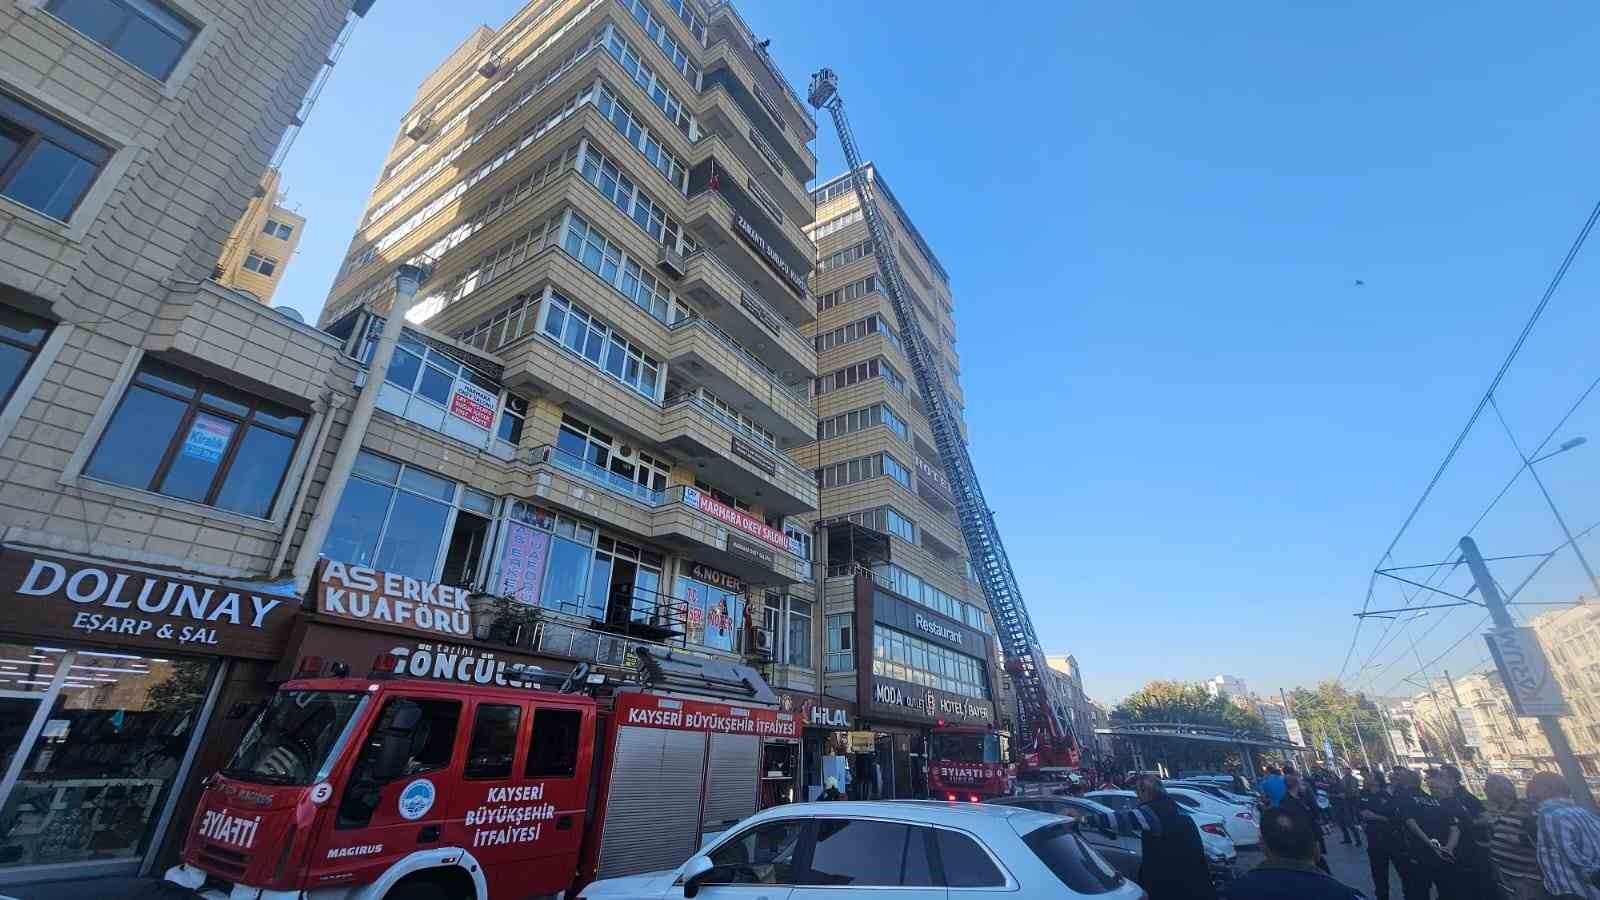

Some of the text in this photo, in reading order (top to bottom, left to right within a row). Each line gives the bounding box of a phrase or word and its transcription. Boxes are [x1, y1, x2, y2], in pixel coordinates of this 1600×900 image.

[700, 496, 741, 528] MARMARA
[742, 518, 762, 535] OKEY
[762, 525, 789, 549] SALONU
[16, 559, 281, 628] DOLUNAY
[321, 560, 471, 611] AS ERKEK
[325, 587, 470, 636] KUAFÖRÜ
[72, 612, 219, 645] EŞARP & ŞAL
[915, 613, 962, 644] Restaurant
[876, 683, 902, 705] MODA
[940, 696, 963, 716] HOTEL
[628, 707, 796, 735] KAYSERİ BÜYÜKŞEHİR İTFAİYESİ
[487, 783, 544, 802] KAYSERİ
[465, 803, 554, 826] BÜYÜKŞEHİR
[473, 823, 540, 847] İTFAİYESİ
[327, 844, 384, 859] MAGIRUS
